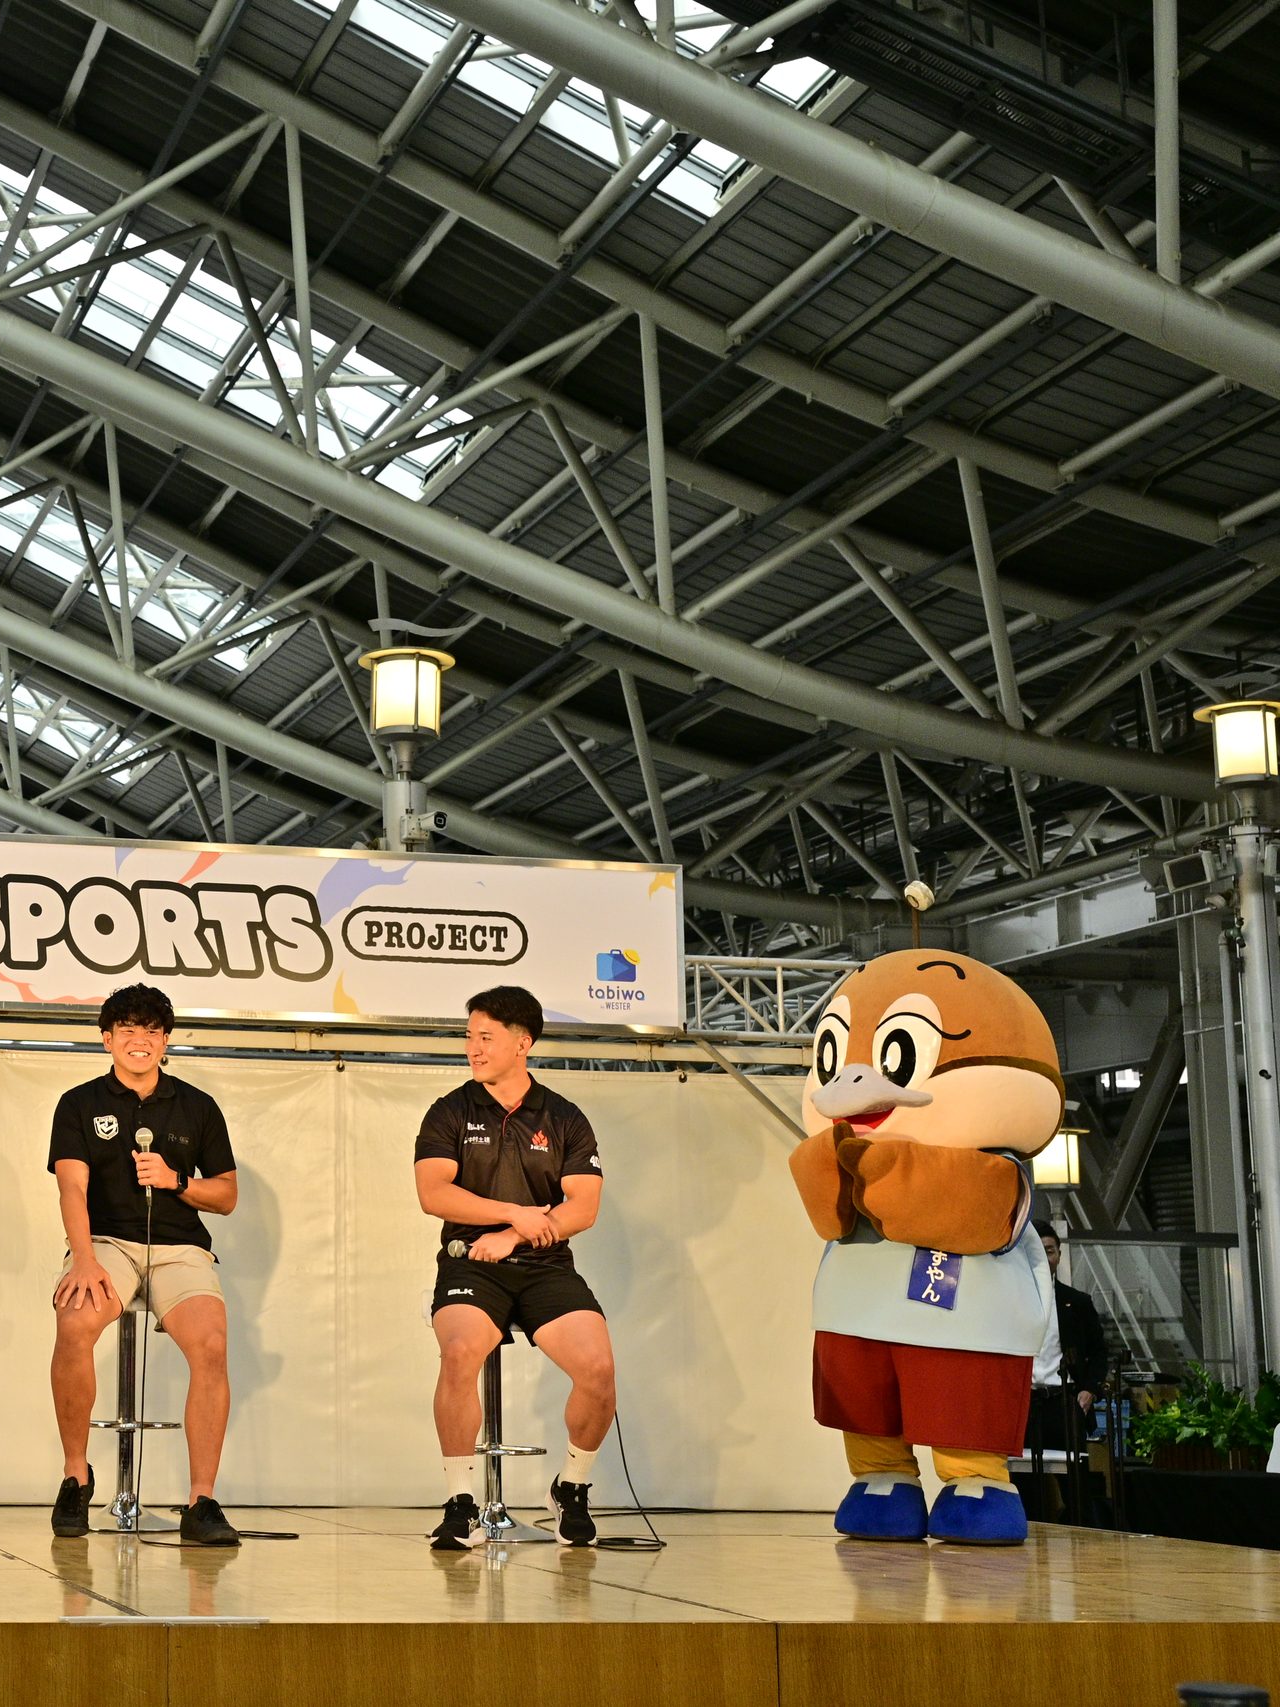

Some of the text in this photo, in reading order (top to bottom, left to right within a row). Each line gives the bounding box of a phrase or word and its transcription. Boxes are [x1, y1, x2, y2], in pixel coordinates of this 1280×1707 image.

[364, 920, 508, 952] PROJECT
[588, 985, 645, 1001] tabiwa
[606, 1002, 631, 1010] WESTER
